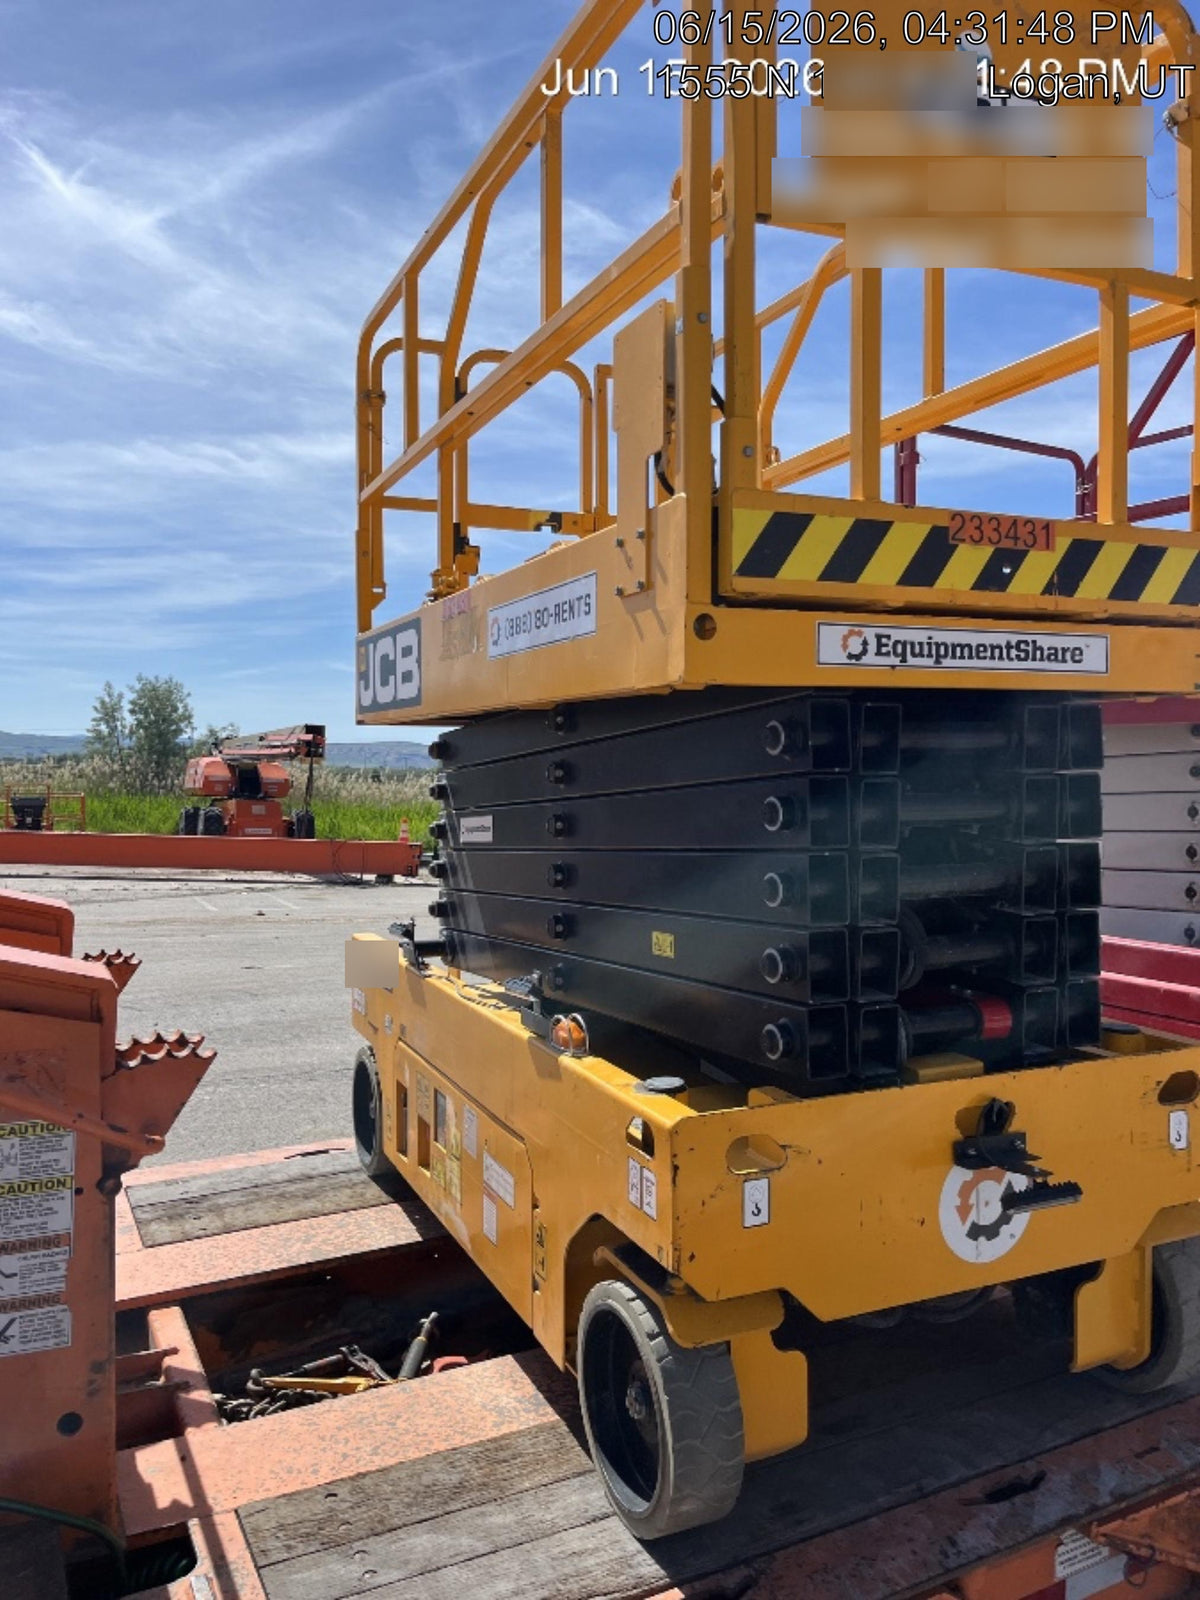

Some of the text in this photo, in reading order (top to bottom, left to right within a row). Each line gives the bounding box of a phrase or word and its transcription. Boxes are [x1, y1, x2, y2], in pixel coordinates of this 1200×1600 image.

[949, 512, 1054, 550] 233431
[874, 632, 1084, 664] EquipmentShare
[359, 628, 421, 707] JCB
